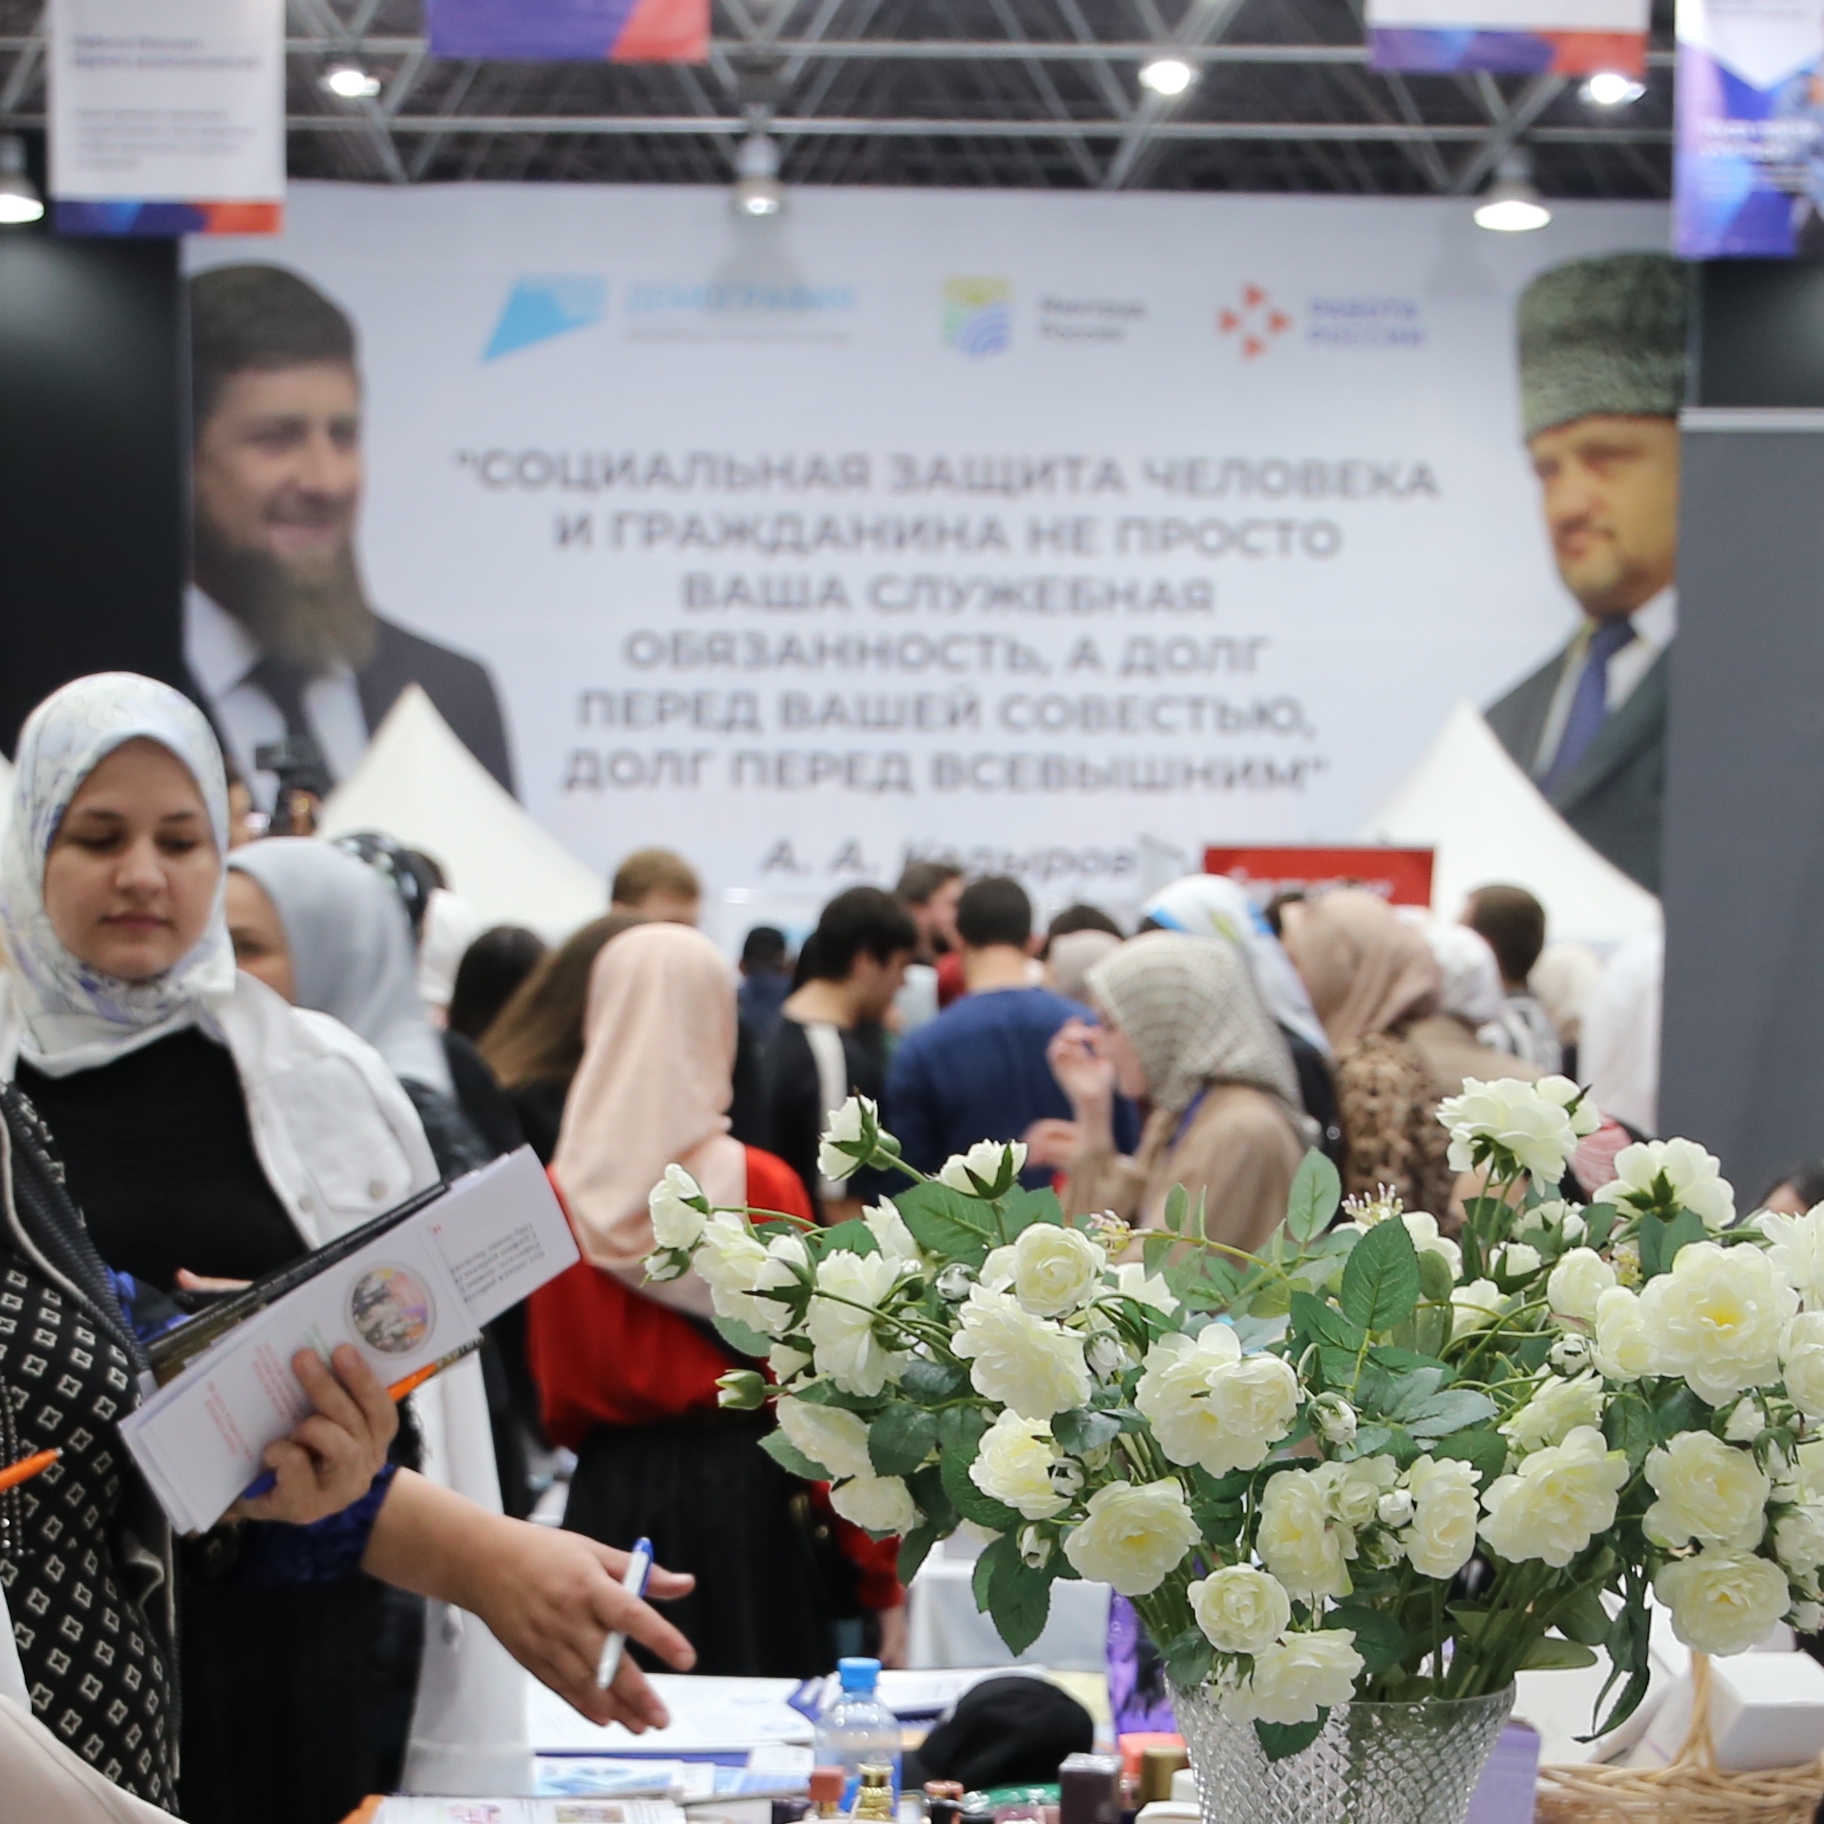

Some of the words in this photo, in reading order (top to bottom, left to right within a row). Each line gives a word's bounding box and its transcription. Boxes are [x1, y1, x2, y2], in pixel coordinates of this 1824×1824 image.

[456, 448, 872, 496] "СОЦИАЛЬНАЯ
[890, 452, 1129, 499] ЗАЩИТА
[1142, 456, 1440, 500] ЧЕЛОВЕКА
[555, 511, 595, 550] И
[609, 512, 1009, 557] ГРАЖДАНИНА
[1028, 516, 1101, 557] НЕ
[1116, 517, 1344, 561] ПРОСТО
[683, 571, 853, 614] ВАША
[866, 573, 1216, 617] СЛУЖЕБНАЯ
[624, 628, 1050, 677] ОБЯЗАННОСТЬ,
[1068, 635, 1104, 675] А
[1118, 635, 1274, 677] ДОЛГ
[578, 688, 763, 733] ПЕРЕД
[781, 684, 982, 734] ВАШЕЙ
[998, 693, 1317, 741] СОВЕСТЬЮ,
[564, 747, 717, 795] ДОЛГ
[730, 749, 914, 795] ПЕРЕД
[929, 752, 1331, 795] ВСЕВЫШНИМ"
[764, 837, 813, 876] А.
[832, 837, 881, 876] А.
